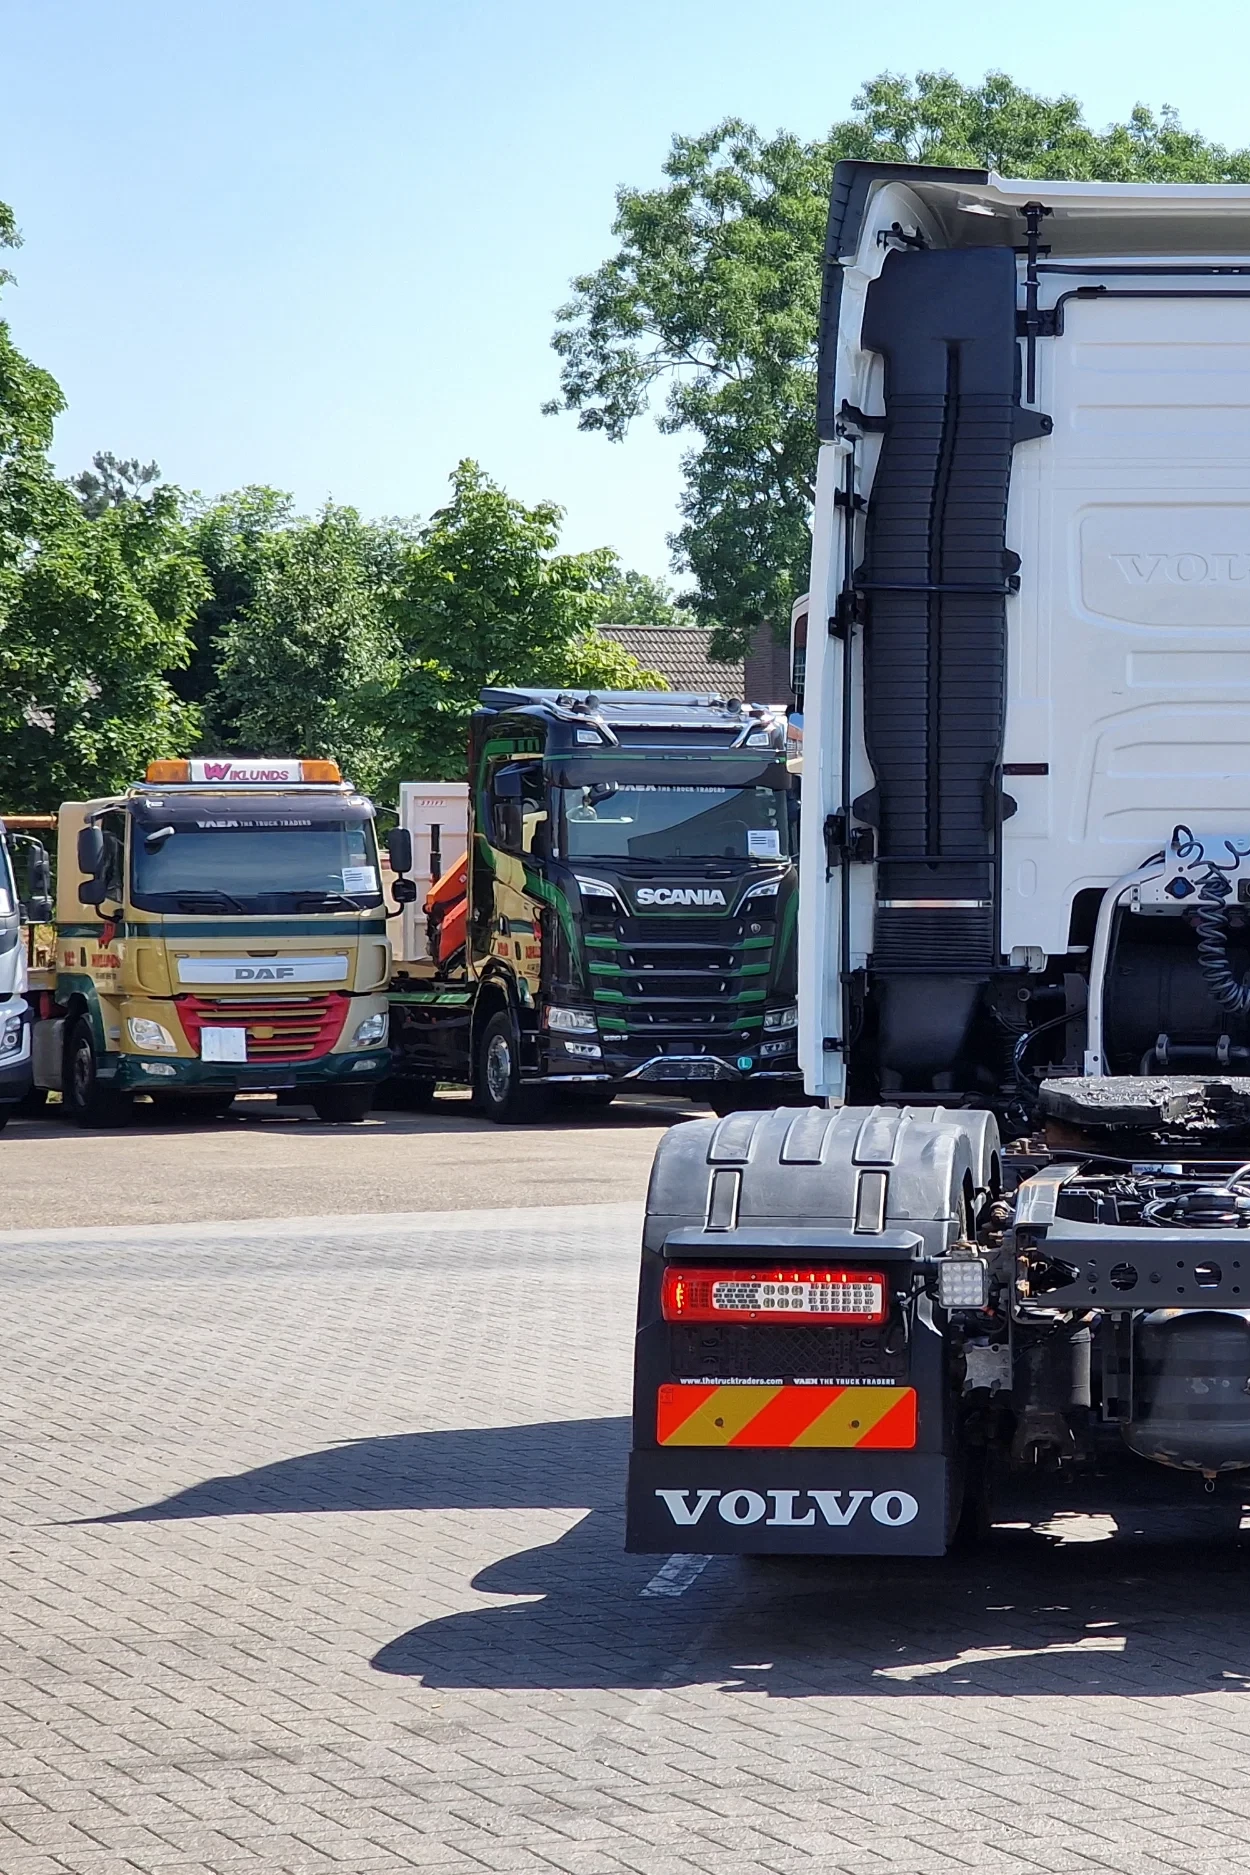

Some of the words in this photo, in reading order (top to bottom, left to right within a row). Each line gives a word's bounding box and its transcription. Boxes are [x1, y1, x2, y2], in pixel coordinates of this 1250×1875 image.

[204, 762, 289, 781] WIKLUNDS
[636, 887, 727, 906] SCANIA
[235, 967, 295, 980] DAF
[680, 1377, 783, 1386] www.thetrucktraders.com
[820, 1378, 834, 1386] THE
[836, 1378, 861, 1386] TRUCK
[862, 1378, 896, 1386] TRADERS
[655, 1489, 919, 1526] VOLVO
